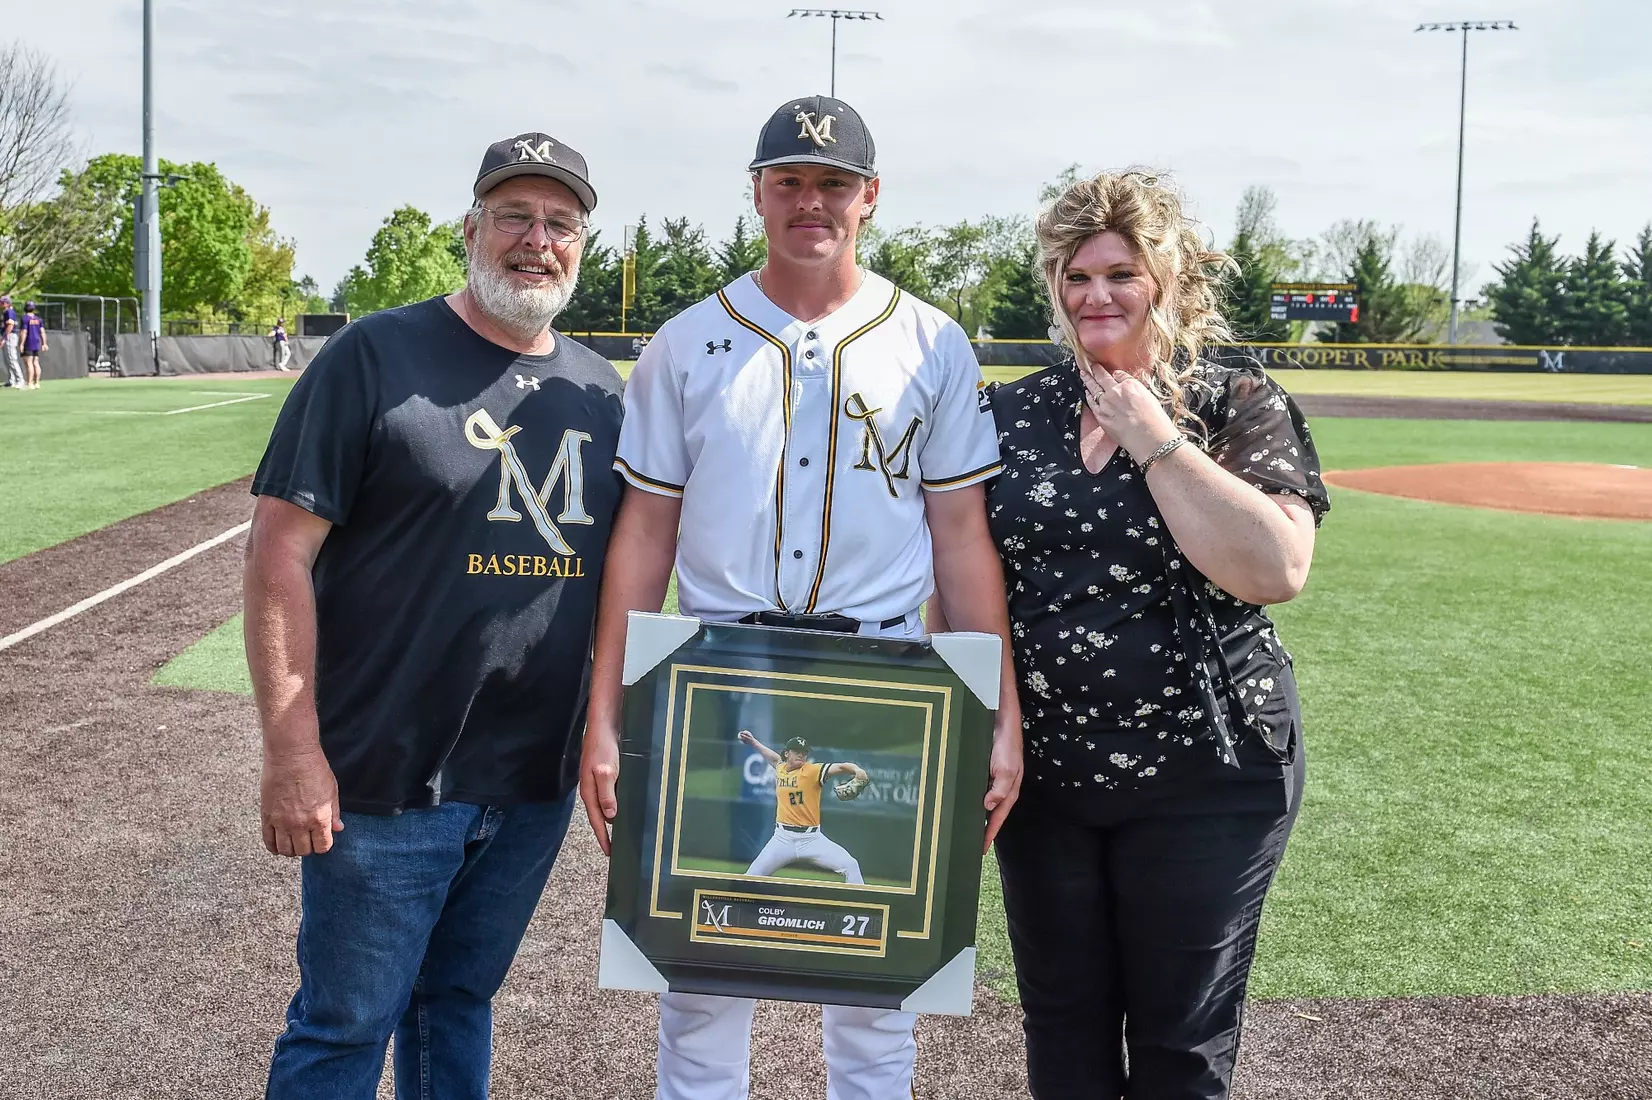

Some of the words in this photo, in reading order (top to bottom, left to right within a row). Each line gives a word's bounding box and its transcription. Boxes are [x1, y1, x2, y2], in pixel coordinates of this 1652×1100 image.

[1272, 347, 1372, 370] COOPER
[1377, 348, 1450, 370] PARK
[466, 553, 585, 577] BASEBALL
[788, 791, 804, 806] 27
[758, 907, 786, 916] COLBY
[757, 916, 826, 931] GROMLICH
[841, 914, 870, 936] 27
